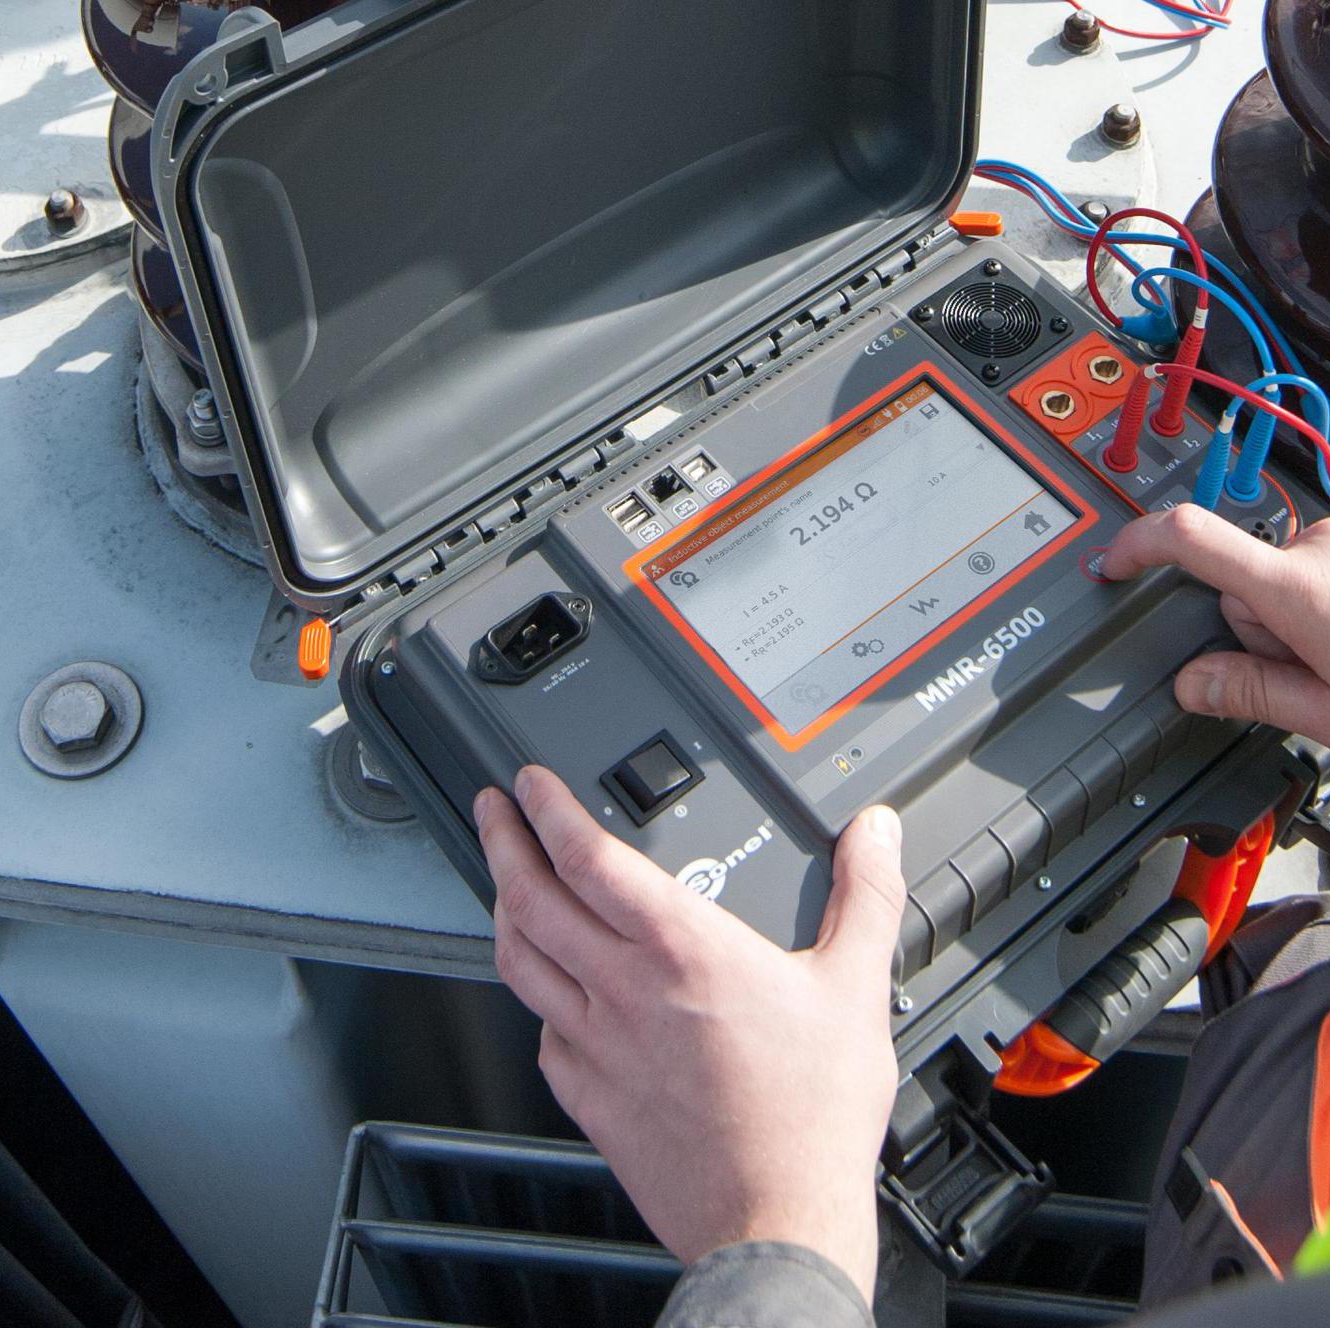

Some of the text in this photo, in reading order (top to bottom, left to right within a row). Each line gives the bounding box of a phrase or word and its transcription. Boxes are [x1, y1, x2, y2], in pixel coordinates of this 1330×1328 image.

[927, 476, 939, 487] 10
[669, 535, 708, 563] Inductive
[708, 517, 735, 538] object
[735, 479, 790, 520] measurement
[705, 489, 813, 565] Measurement point's name
[789, 495, 854, 546] 2.194
[1268, 507, 1288, 524] TEMP
[761, 590, 778, 606] 4.5
[915, 607, 1045, 712] MMR-6500
